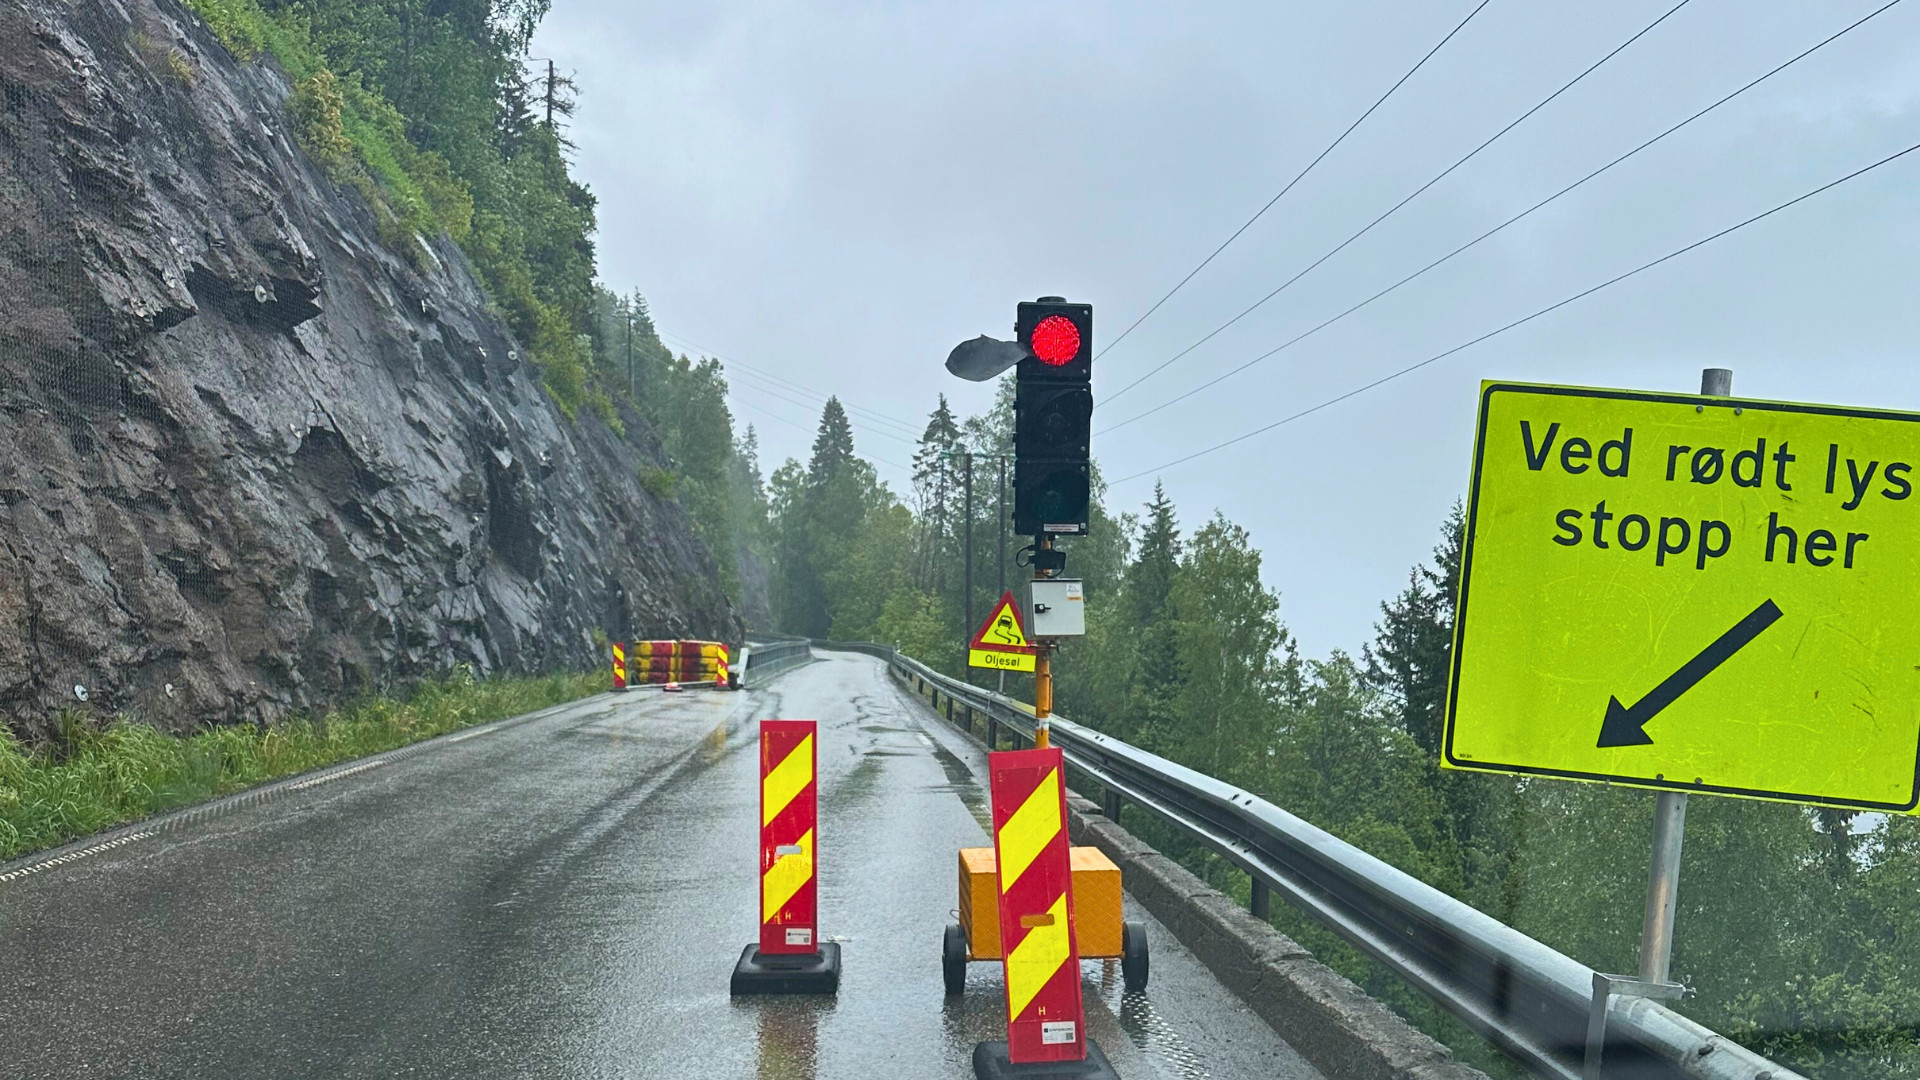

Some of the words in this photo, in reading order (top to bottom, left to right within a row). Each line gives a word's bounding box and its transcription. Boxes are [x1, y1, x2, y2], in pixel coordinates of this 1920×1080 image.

[1519, 420, 1634, 478] Ved
[1665, 437, 1796, 492] rødt
[1824, 443, 1913, 511] lys
[1552, 499, 1732, 571] stopp
[1764, 511, 1870, 569] her
[985, 654, 1020, 668] Oljesøl
[1038, 1006, 1046, 1016] H
